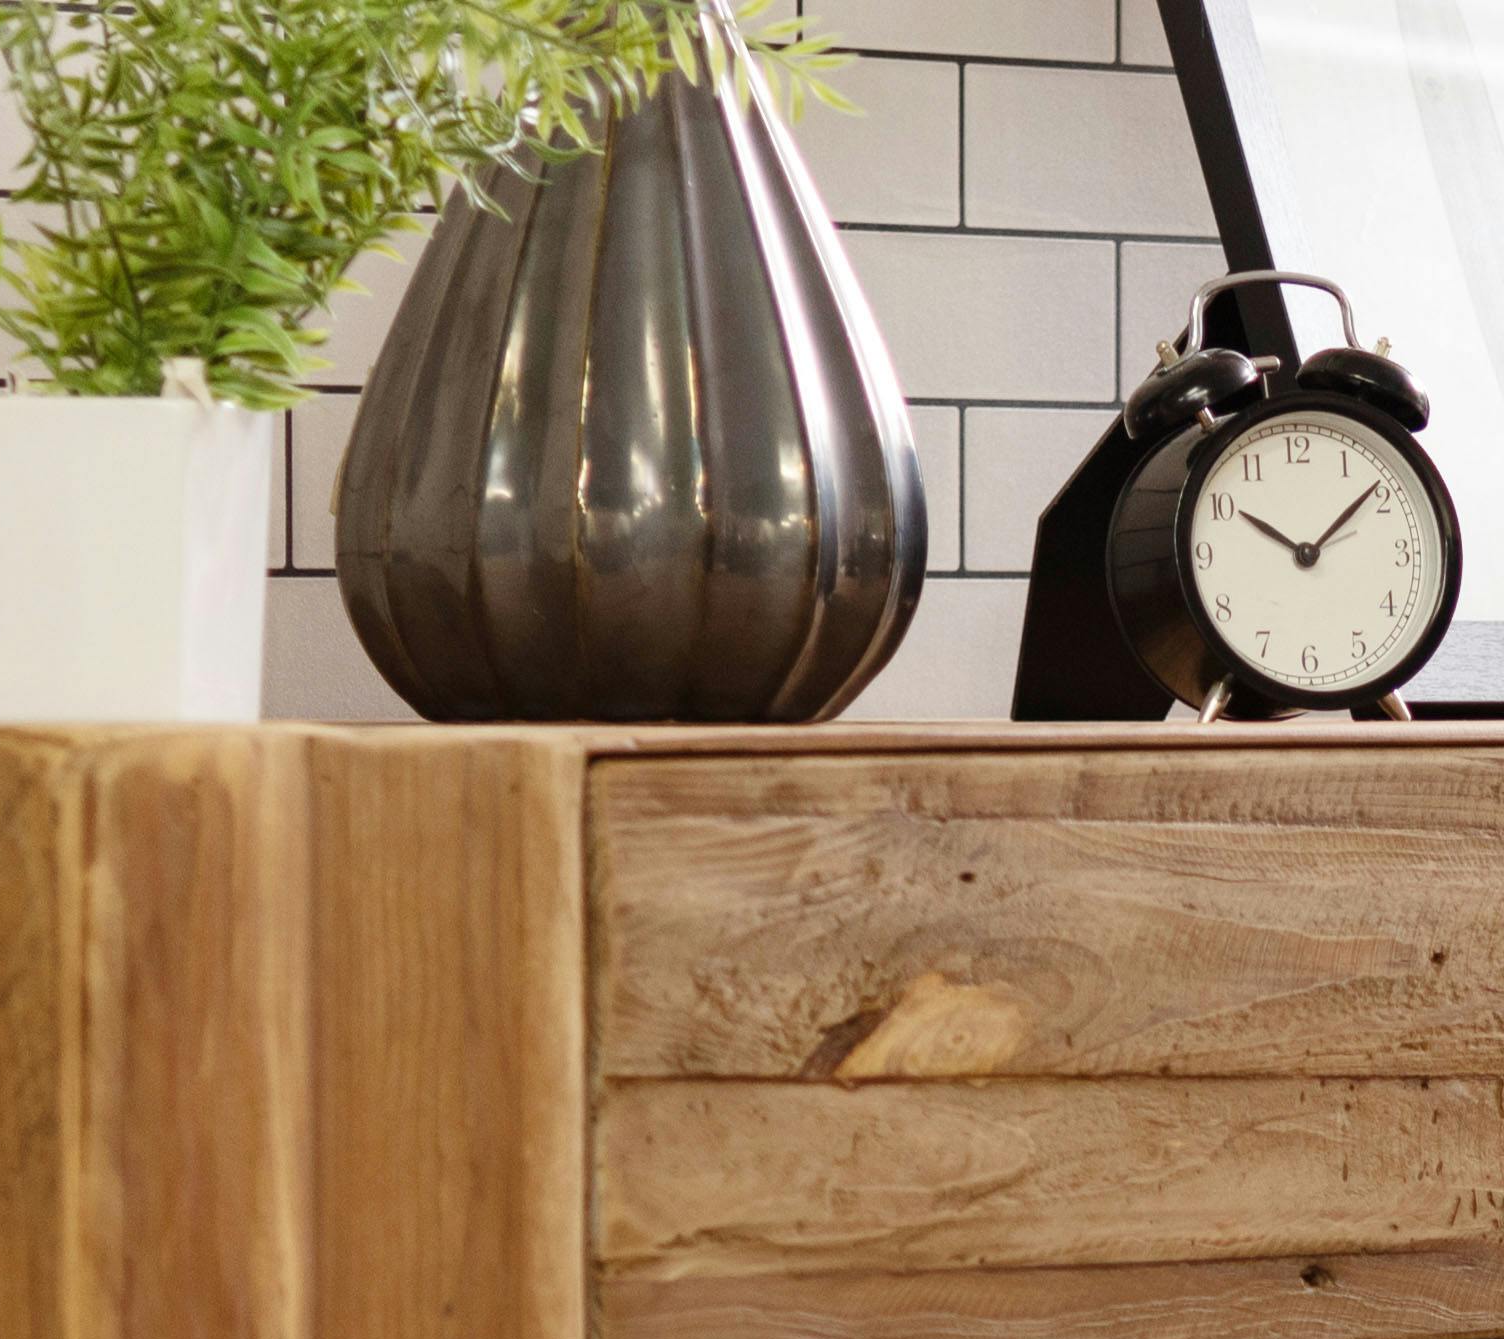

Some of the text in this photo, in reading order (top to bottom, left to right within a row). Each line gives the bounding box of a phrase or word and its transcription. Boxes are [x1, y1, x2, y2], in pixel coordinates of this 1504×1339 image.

[1284, 436, 1310, 464] 12
[1339, 450, 1351, 478] 1
[1241, 454, 1263, 482] 11
[1210, 492, 1235, 520] 10
[1375, 485, 1391, 513] 2
[1196, 542, 1213, 569] 9
[1394, 540, 1411, 567] 3
[1215, 594, 1232, 621] 8
[1379, 590, 1398, 617] 4
[1255, 631, 1271, 658] 7
[1351, 630, 1367, 658] 5
[1301, 645, 1319, 673] 6
